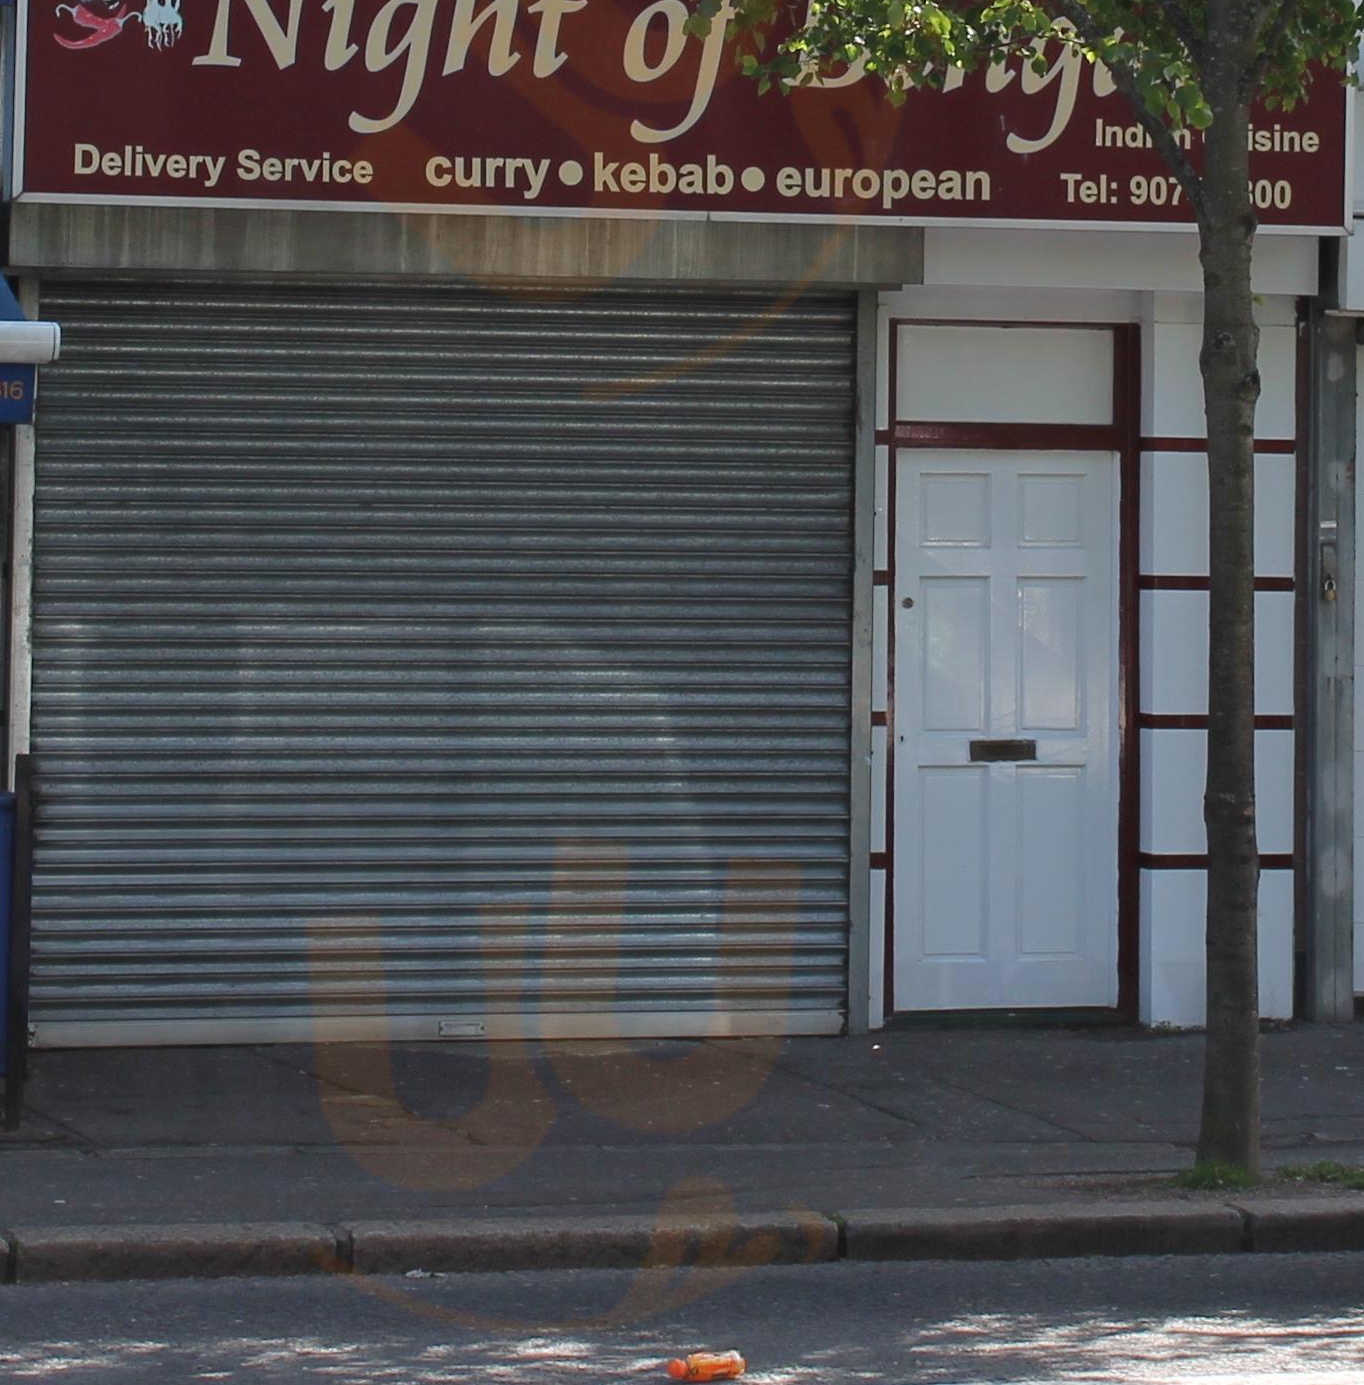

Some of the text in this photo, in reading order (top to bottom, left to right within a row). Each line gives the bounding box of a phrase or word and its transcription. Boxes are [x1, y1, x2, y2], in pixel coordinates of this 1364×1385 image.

[73, 143, 374, 187] Delivery Service
[425, 152, 991, 209] curry kebab european
[1059, 172, 1118, 204] Tel:
